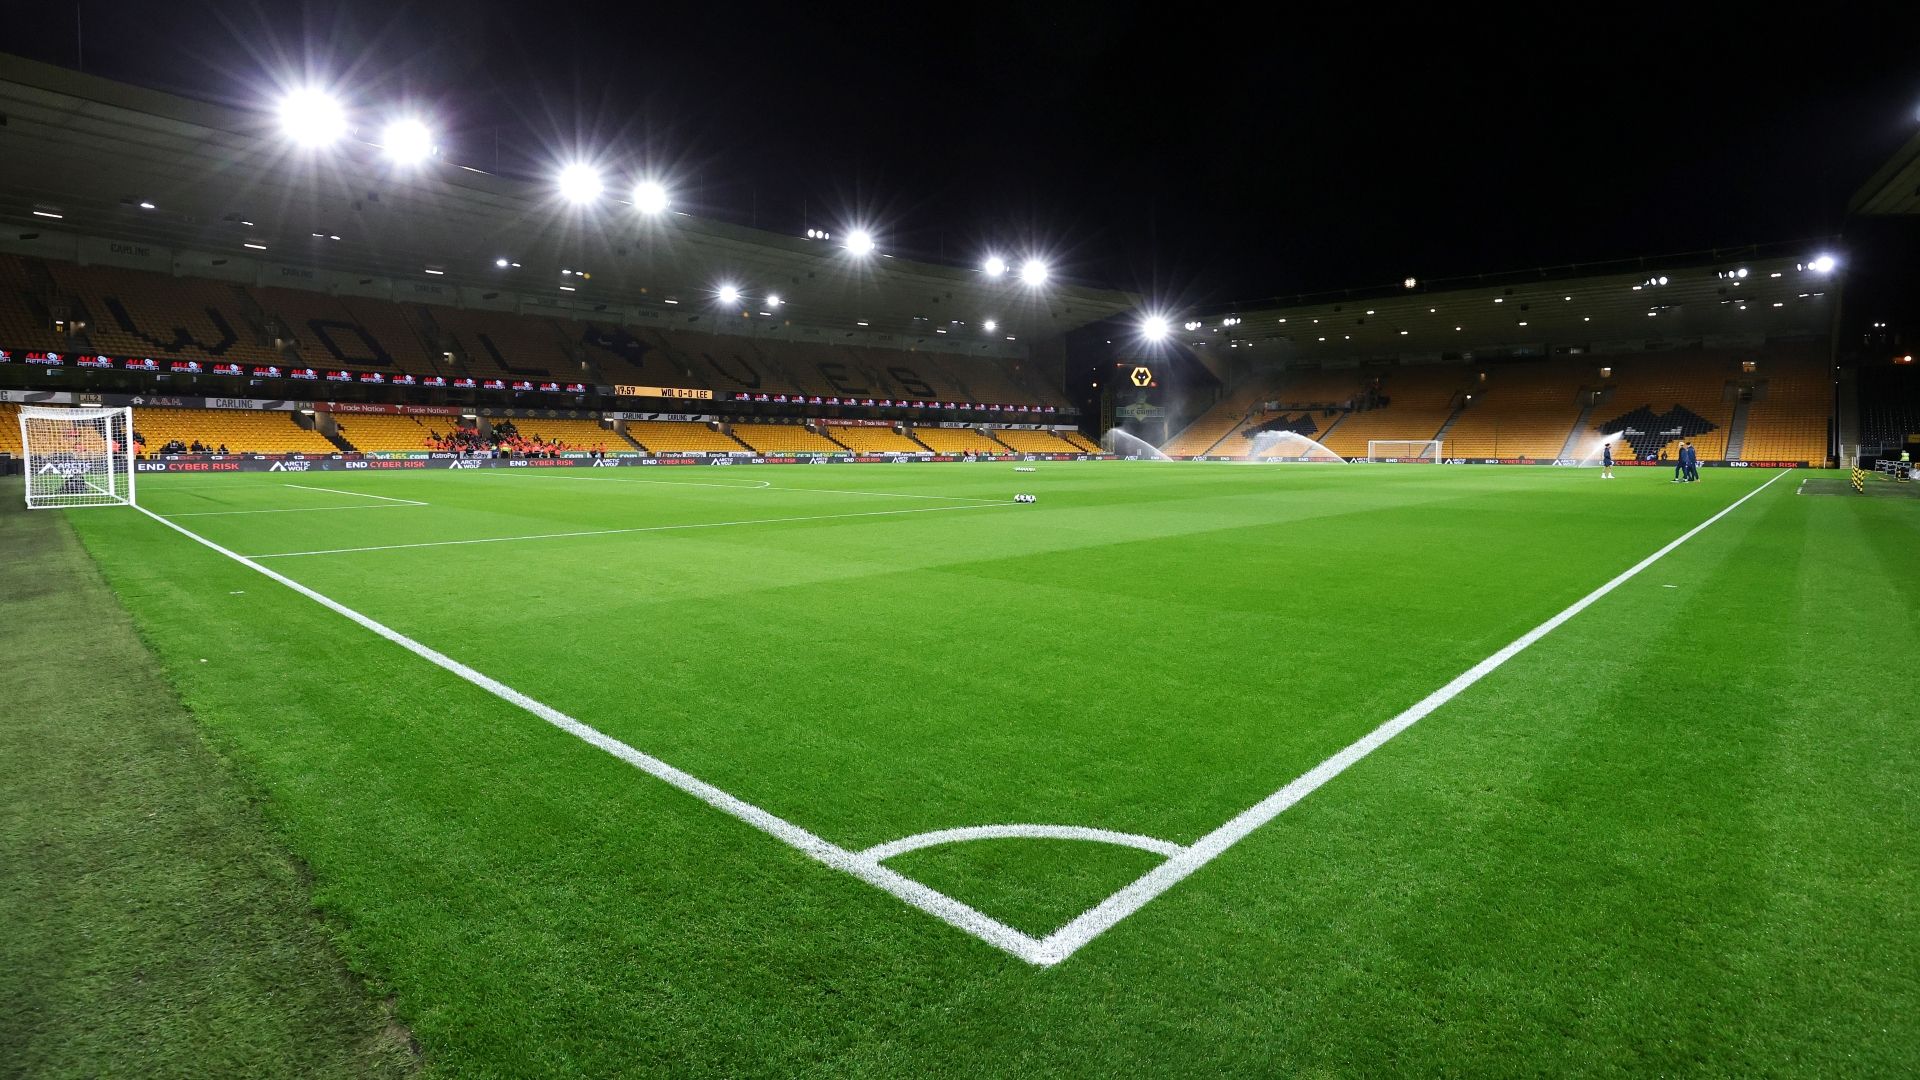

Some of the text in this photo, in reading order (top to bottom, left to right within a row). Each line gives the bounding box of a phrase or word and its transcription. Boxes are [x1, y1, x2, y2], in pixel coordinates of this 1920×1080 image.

[661, 388, 675, 397] WOL
[696, 390, 708, 399] LEE
[216, 398, 253, 409] CARLING
[340, 404, 385, 413] Trade Nation
[622, 412, 644, 420] CARLING
[431, 452, 457, 460] AstroPay
[138, 463, 166, 471] END
[212, 462, 239, 470] RISK
